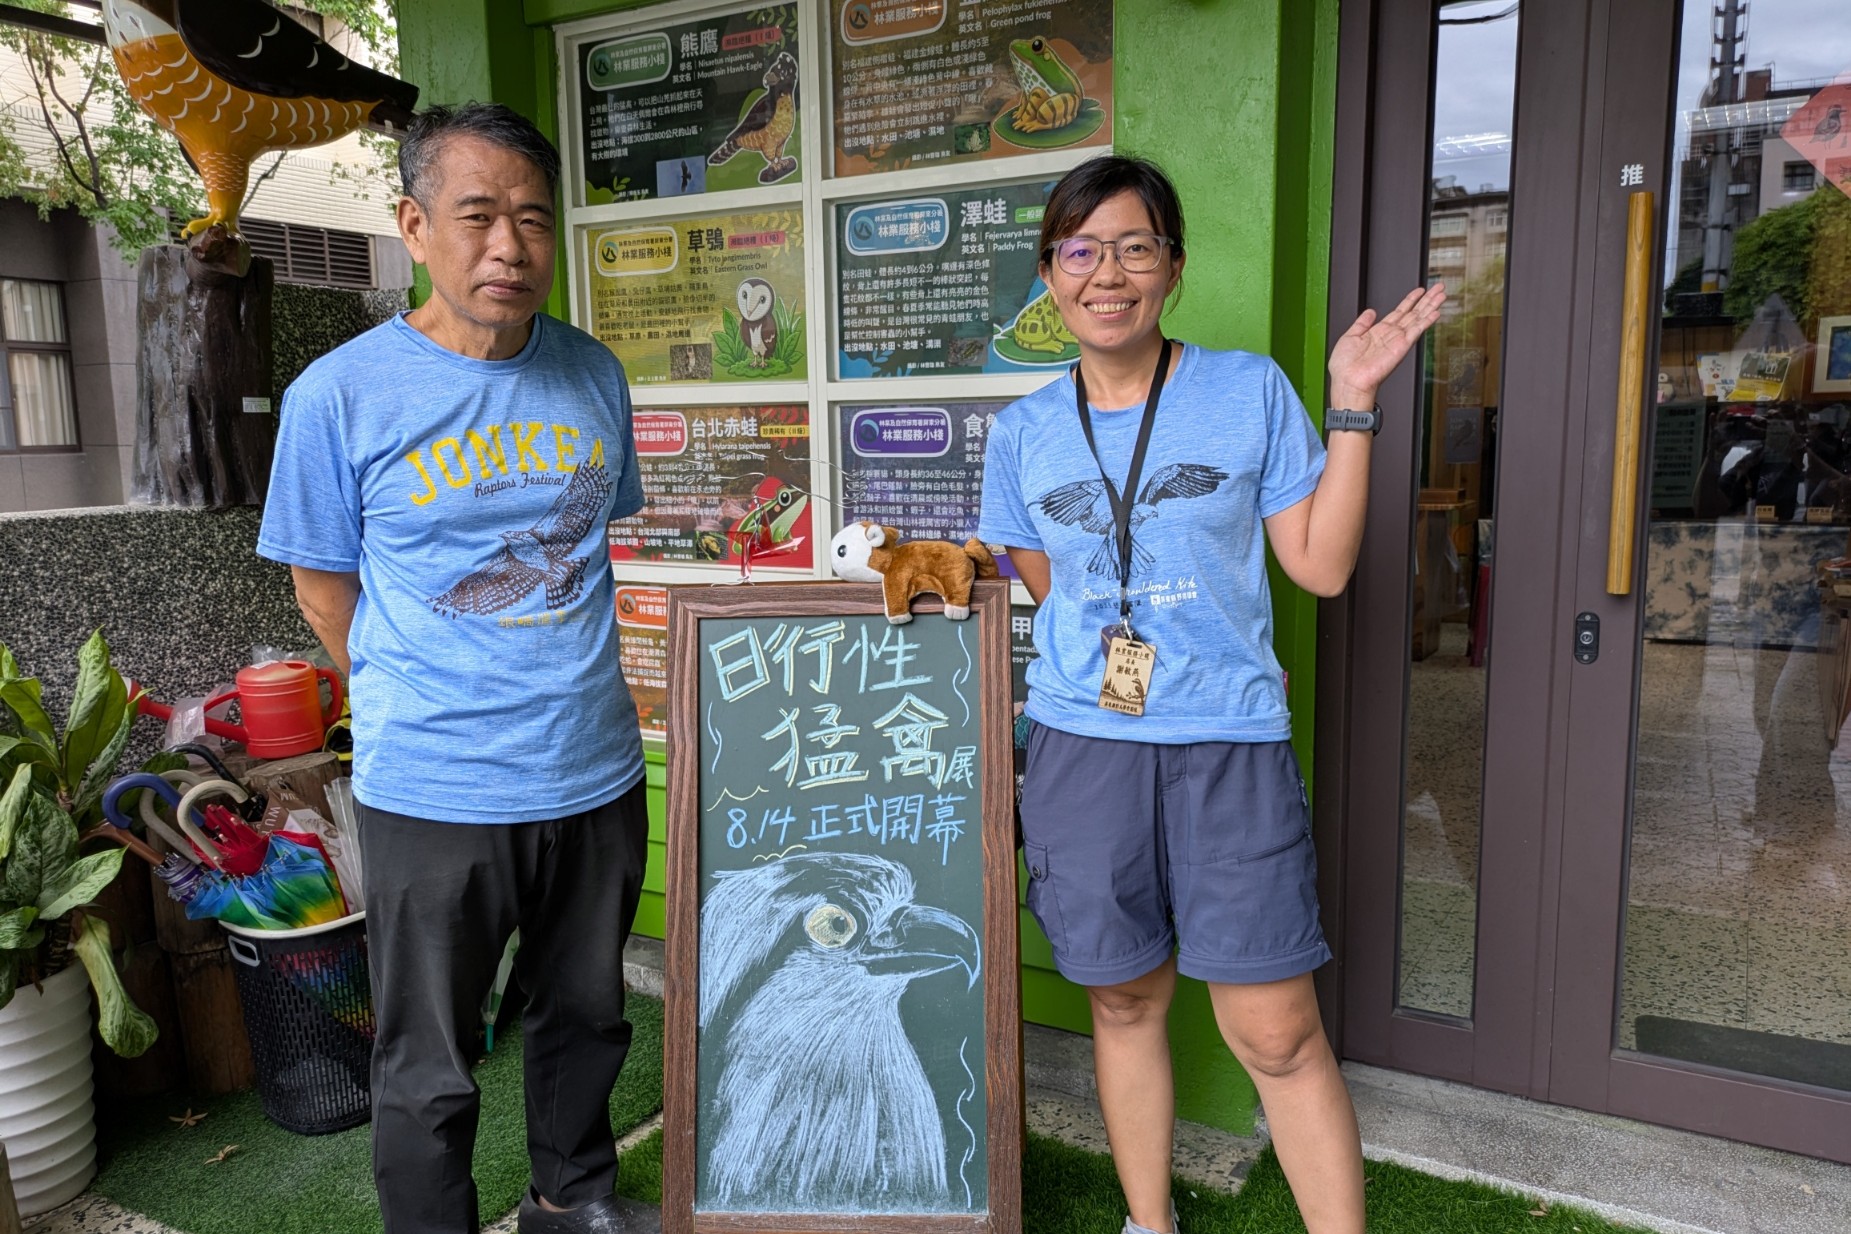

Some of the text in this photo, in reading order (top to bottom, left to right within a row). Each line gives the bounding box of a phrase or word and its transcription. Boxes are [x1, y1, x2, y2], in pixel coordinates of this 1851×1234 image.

[958, 10, 974, 21] 學名
[958, 11, 1051, 34] 英文名 Green pond frog
[680, 29, 718, 58] 熊鷹
[614, 53, 665, 72] 林業服務小棧
[680, 51, 754, 71] 學名 Nisaetus nipalensis
[672, 61, 763, 84] 英文名 Mountain Hawk-Eagle
[1620, 163, 1644, 187] 推
[960, 198, 1007, 228] 澤蛙
[878, 220, 941, 238] 林業服務小棧
[961, 232, 977, 243] 學名
[984, 230, 1022, 241] Fejervarya
[687, 227, 724, 253] 草鴞
[961, 241, 1034, 255] 英文名 Paddy Frog
[622, 246, 672, 260] 林業服務小棧
[690, 262, 768, 276] 英文名 Eastern Grass Owl
[691, 418, 758, 439] 台北赤蛙
[882, 428, 944, 442] 林業服務小棧
[965, 442, 981, 452] 學名
[736, 453, 752, 462] grass
[474, 472, 567, 498] Raptors Festival
[1012, 616, 1031, 639] 甲
[708, 619, 934, 703] 日行性
[726, 791, 967, 866] 8.14 正式開幕
